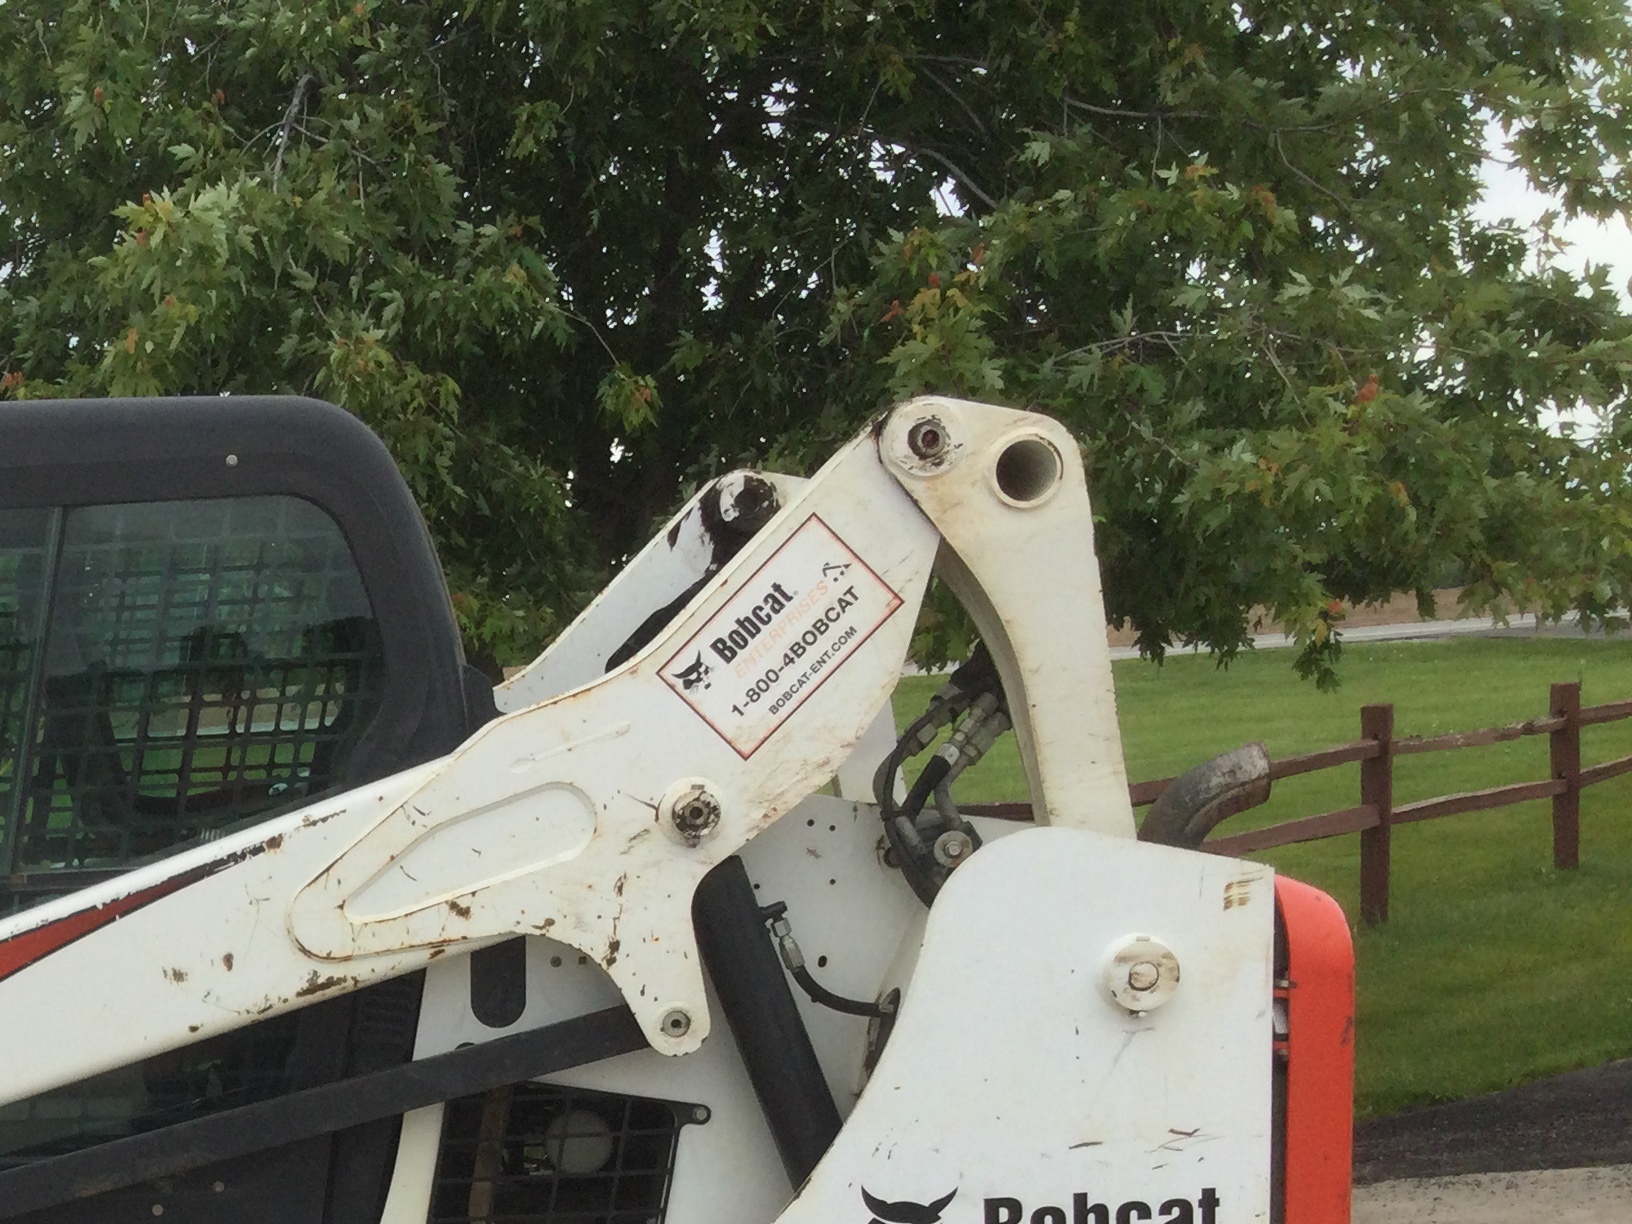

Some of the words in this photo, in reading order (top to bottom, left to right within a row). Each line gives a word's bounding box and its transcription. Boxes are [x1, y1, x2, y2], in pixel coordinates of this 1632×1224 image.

[709, 582, 794, 664] Bobcat
[731, 585, 859, 717] 1-800-4BOBCAT
[735, 580, 828, 679] ENTERPRISES
[768, 625, 858, 715] BOBCAT-ENT.COM
